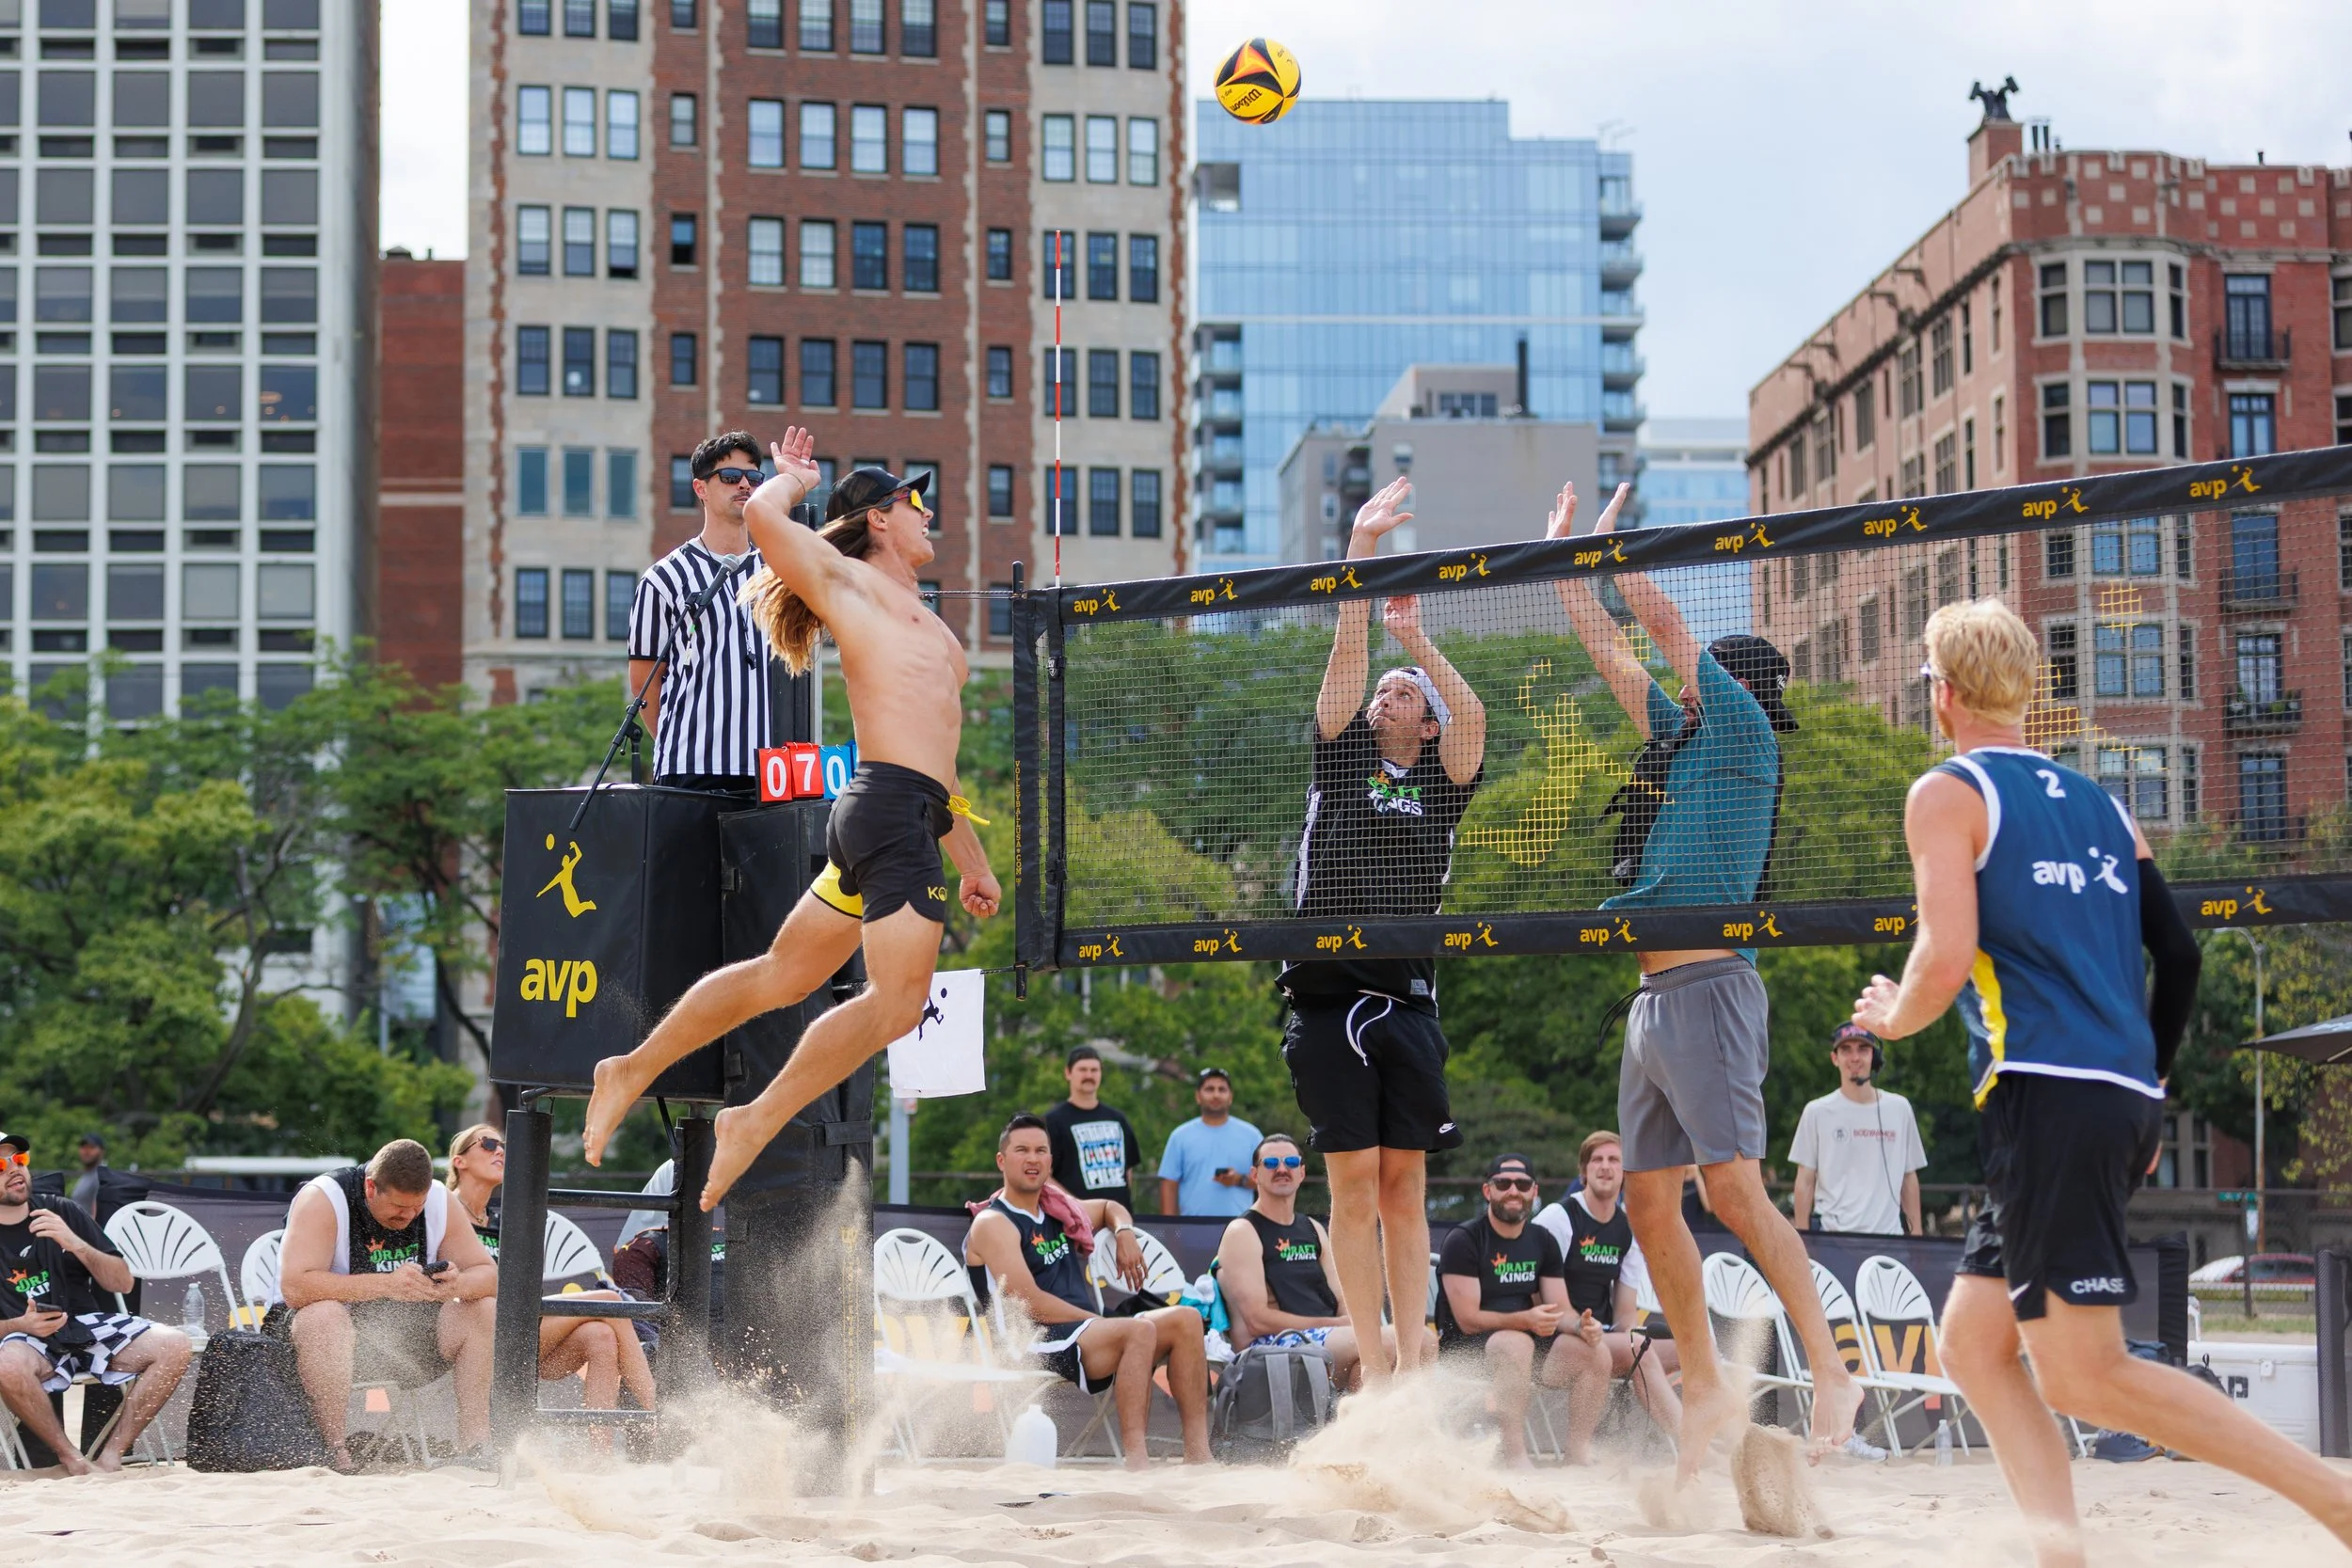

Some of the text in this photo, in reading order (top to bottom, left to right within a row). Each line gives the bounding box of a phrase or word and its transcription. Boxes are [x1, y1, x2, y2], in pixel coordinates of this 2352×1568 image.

[1231, 88, 1262, 111] Wilson
[2189, 479, 2228, 500] avp
[2022, 499, 2058, 520] avp
[1863, 518, 1898, 538] avp
[1714, 534, 1744, 554] avp
[1573, 550, 1603, 569] avp
[1438, 563, 1468, 582] avp
[1311, 576, 1337, 594] avp
[1190, 588, 1216, 606] avp
[1073, 598, 1099, 616] avp
[2036, 769, 2066, 798] 2
[2032, 861, 2086, 894] avp
[2201, 898, 2238, 920] avp
[1723, 922, 1754, 942] avp
[1873, 916, 1906, 936] avp
[1315, 935, 1343, 953] avp
[1444, 932, 1472, 951] avp
[1580, 927, 1610, 947] avp
[1078, 943, 1103, 961] avp
[1193, 939, 1219, 957] avp
[520, 958, 597, 1018] avp
[1581, 1243, 1622, 1256] DRAFT
[1584, 1253, 1619, 1265] KINGS
[1494, 1260, 1537, 1276] DRAFT
[1500, 1271, 1536, 1284] KINGS
[2070, 1276, 2126, 1295] CHASE
